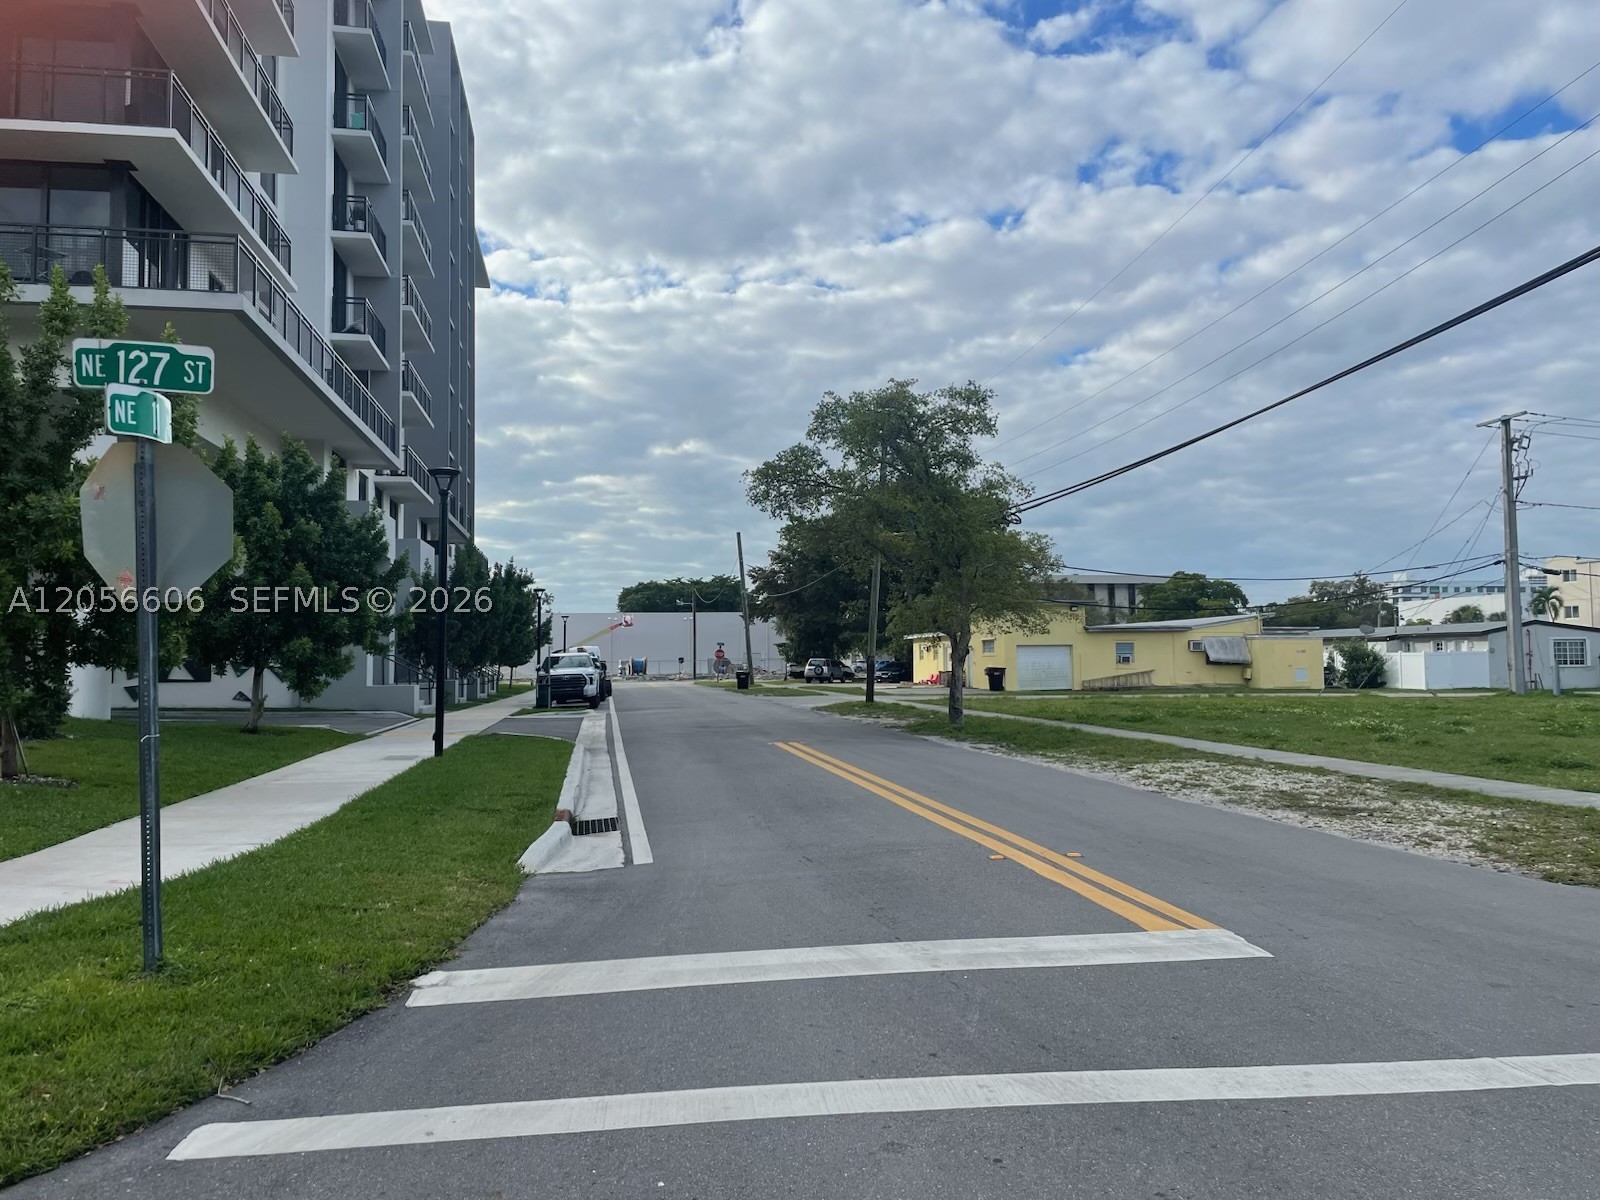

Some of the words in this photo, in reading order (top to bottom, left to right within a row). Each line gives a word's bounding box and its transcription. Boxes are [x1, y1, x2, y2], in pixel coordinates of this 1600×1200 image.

[81, 353, 106, 377] NE
[117, 350, 170, 385] 127
[183, 360, 206, 384] ST
[114, 399, 137, 425] NE
